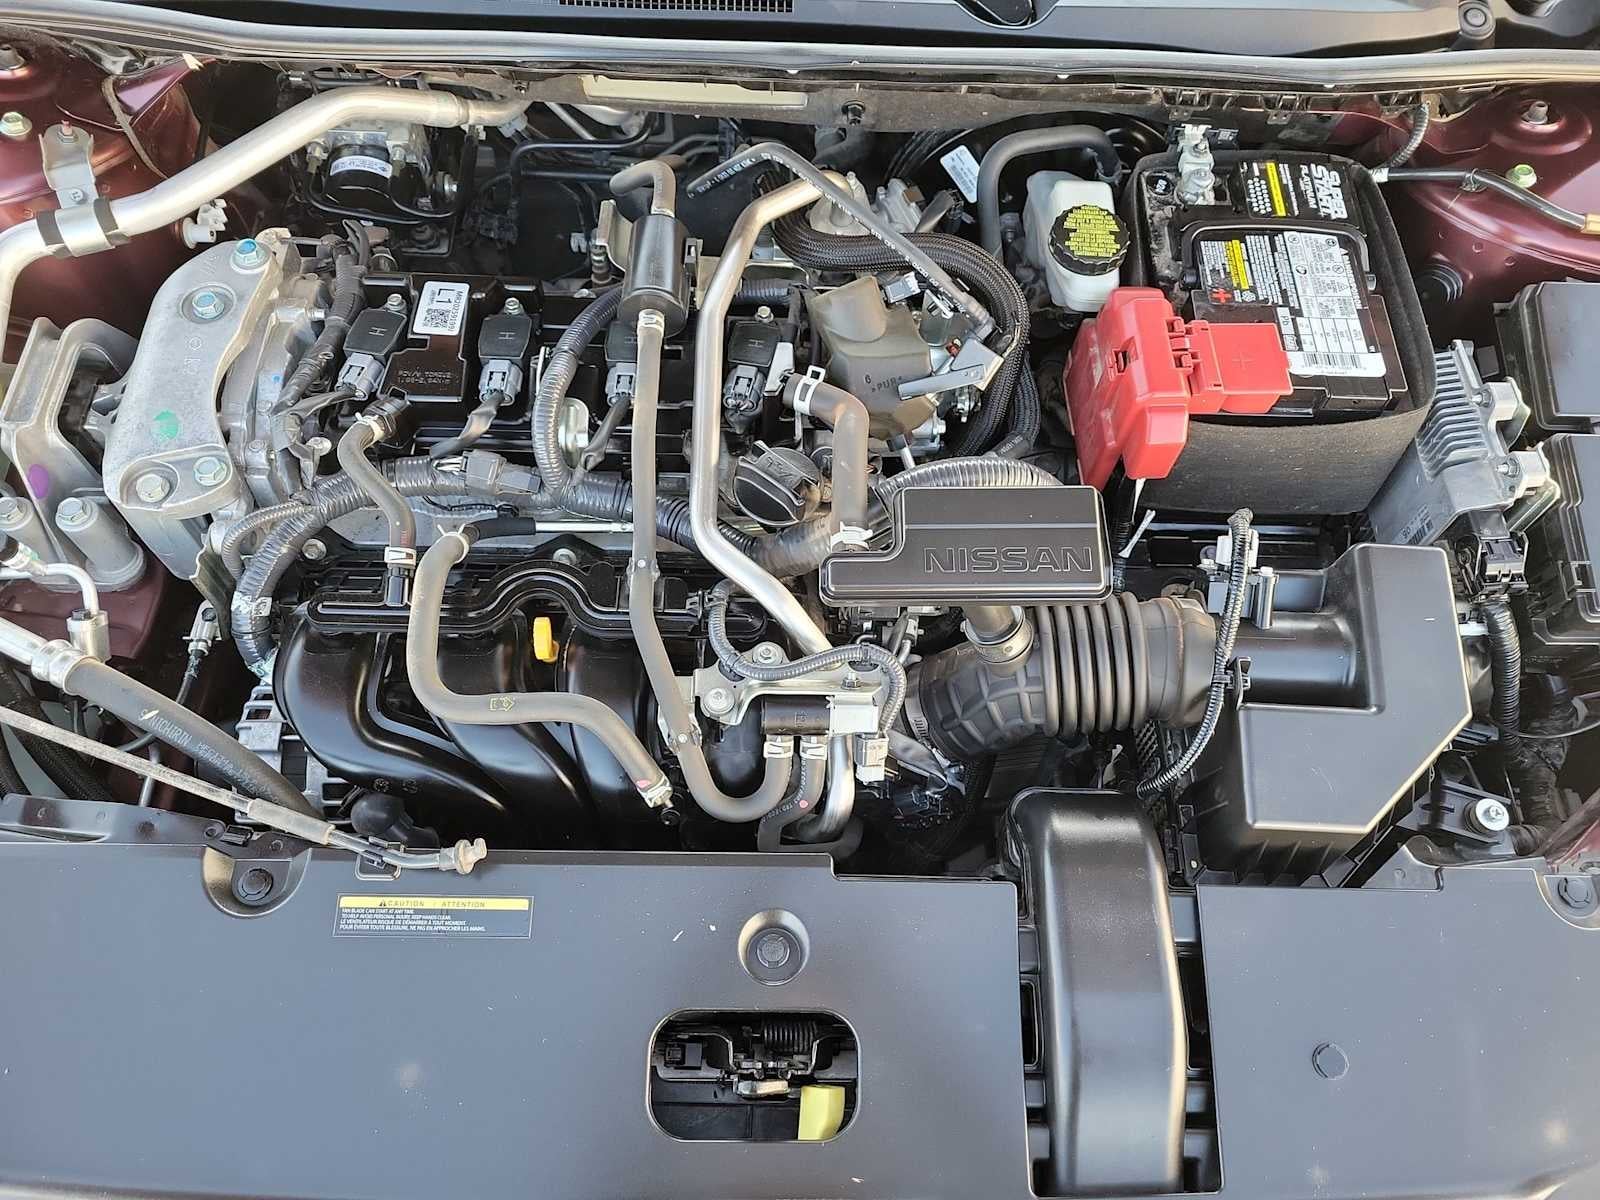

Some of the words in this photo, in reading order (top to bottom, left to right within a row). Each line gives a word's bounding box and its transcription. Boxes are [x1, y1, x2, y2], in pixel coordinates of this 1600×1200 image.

[1300, 164, 1318, 209] PLATINUM
[1310, 163, 1333, 218] START
[1329, 171, 1348, 220] SUPER
[1282, 315, 1289, 326] Pb
[924, 546, 1093, 573] NISSAN
